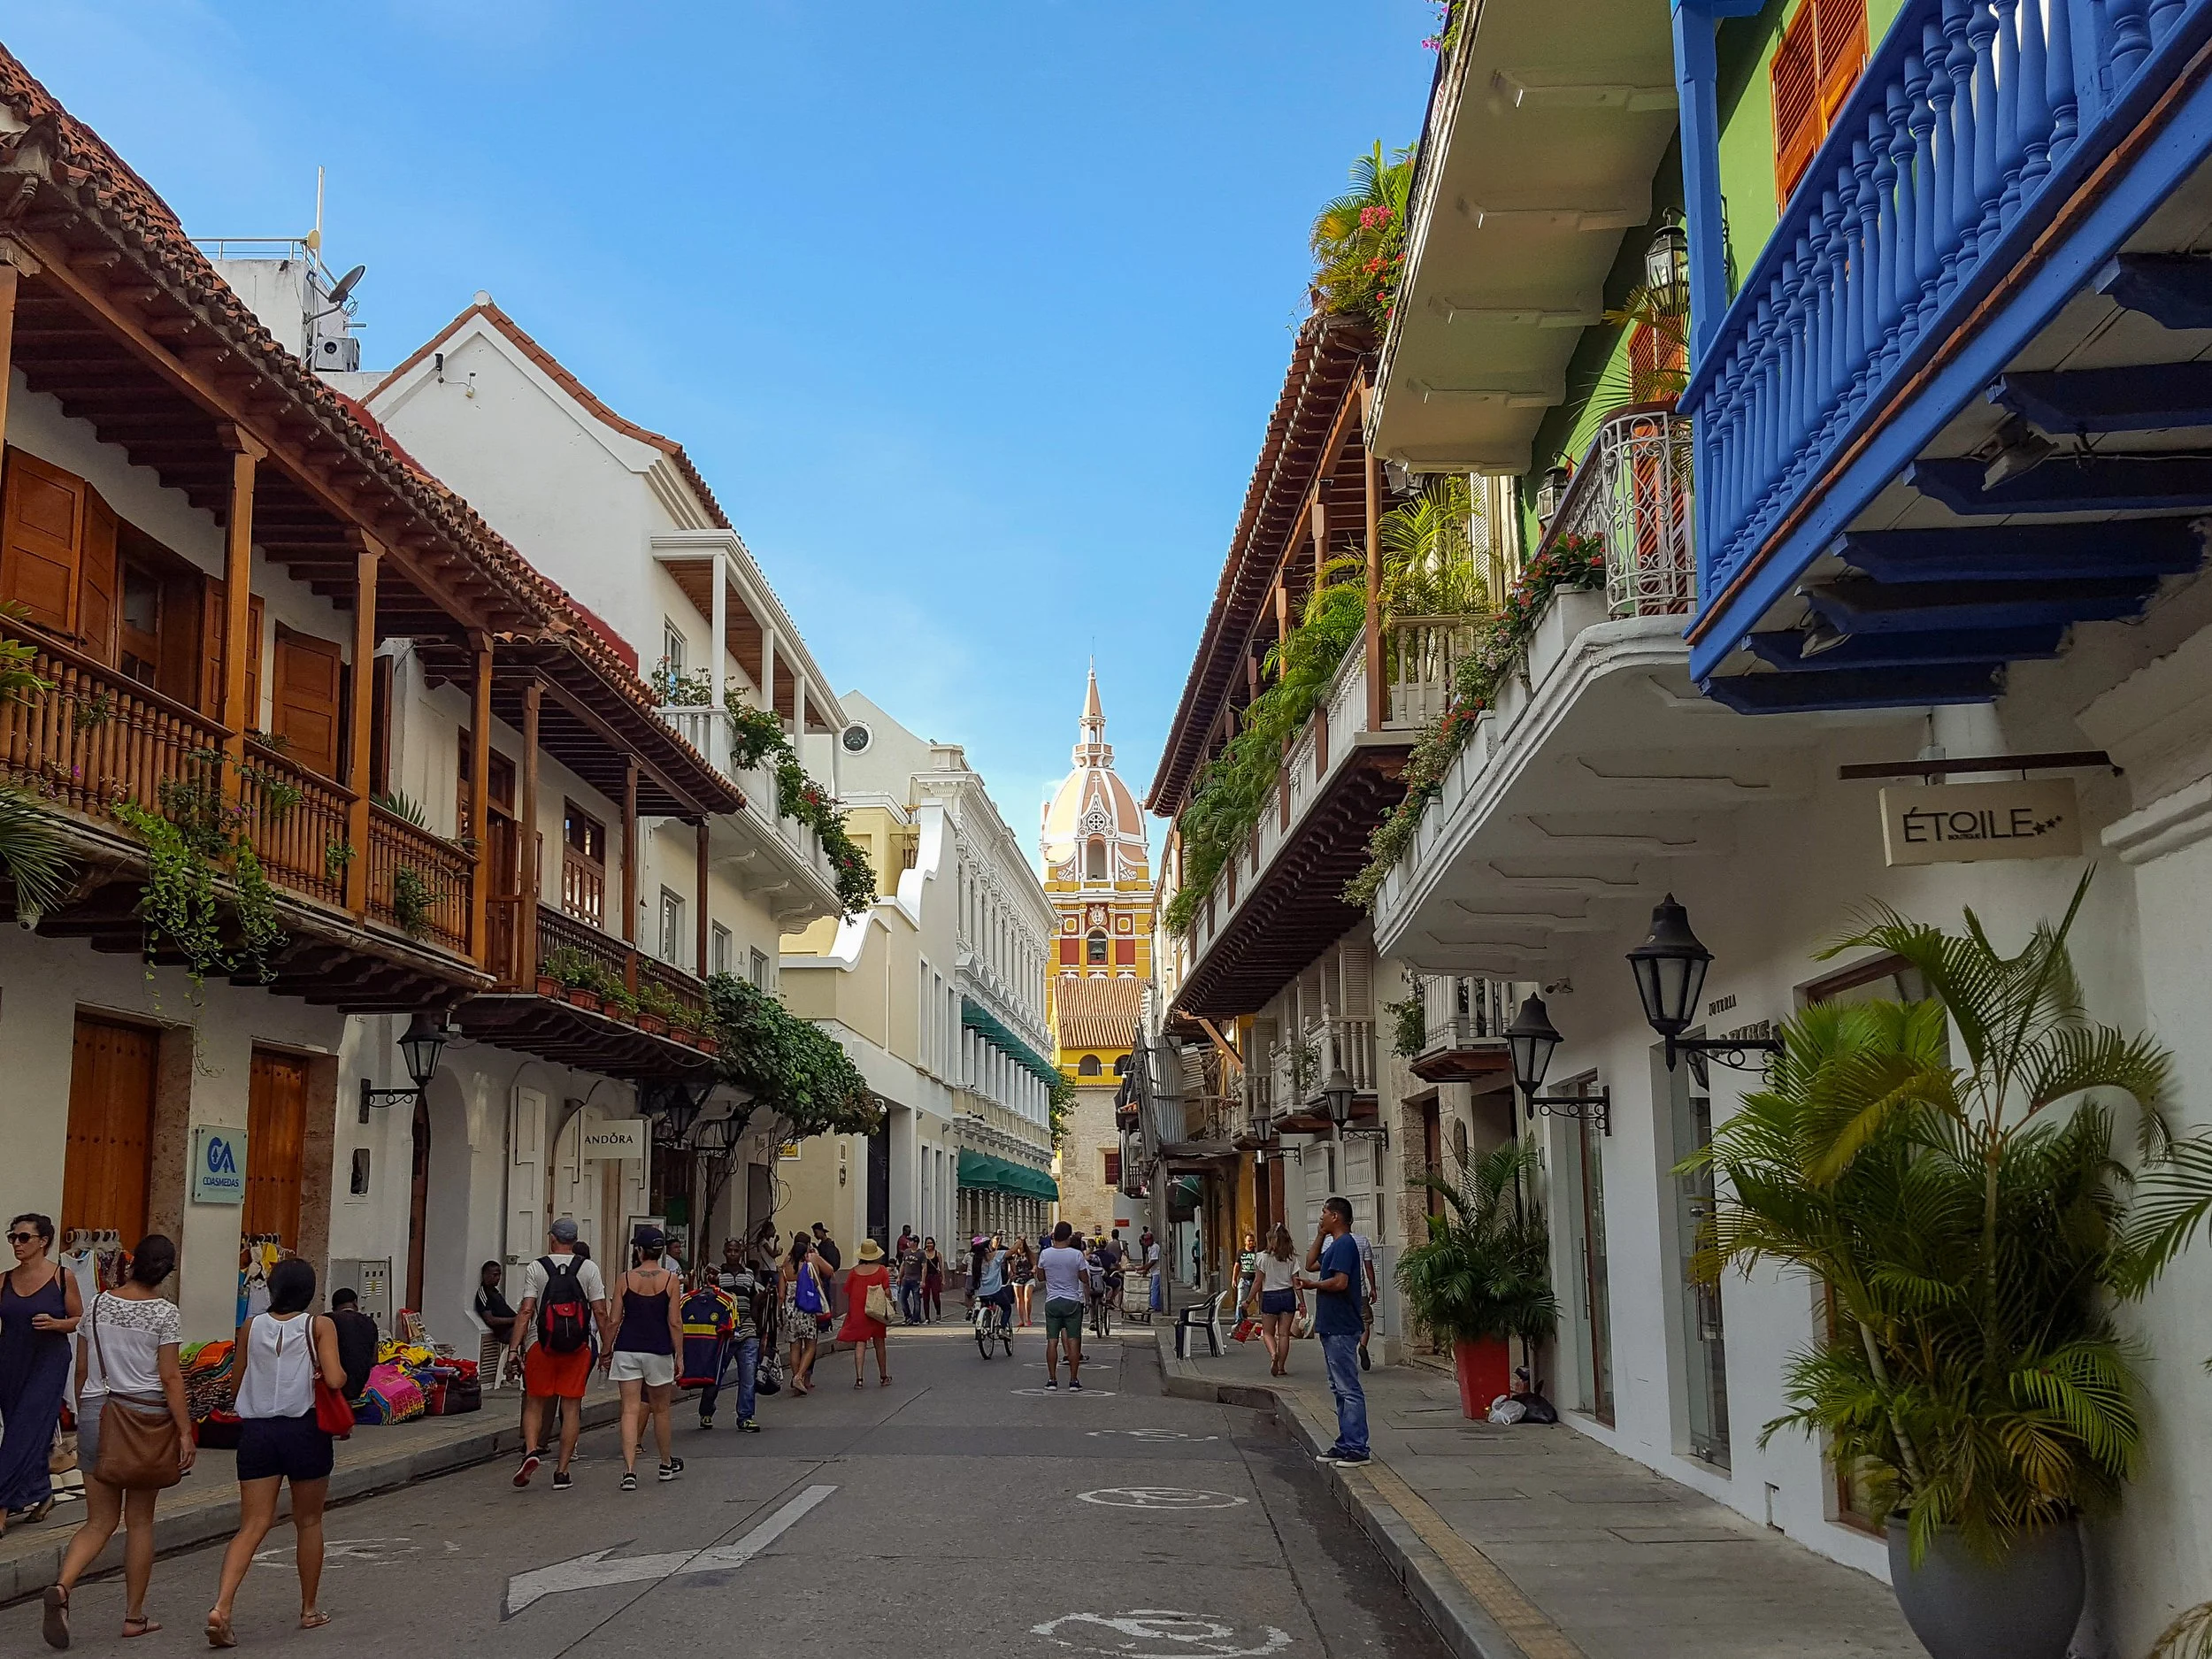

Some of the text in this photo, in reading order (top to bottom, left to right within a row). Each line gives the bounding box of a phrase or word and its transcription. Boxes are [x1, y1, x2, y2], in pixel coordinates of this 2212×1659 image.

[1902, 806, 2035, 842] ÉTOILE
[584, 1133, 634, 1144] ANDORA
[203, 1177, 239, 1187] COASMEDAS
